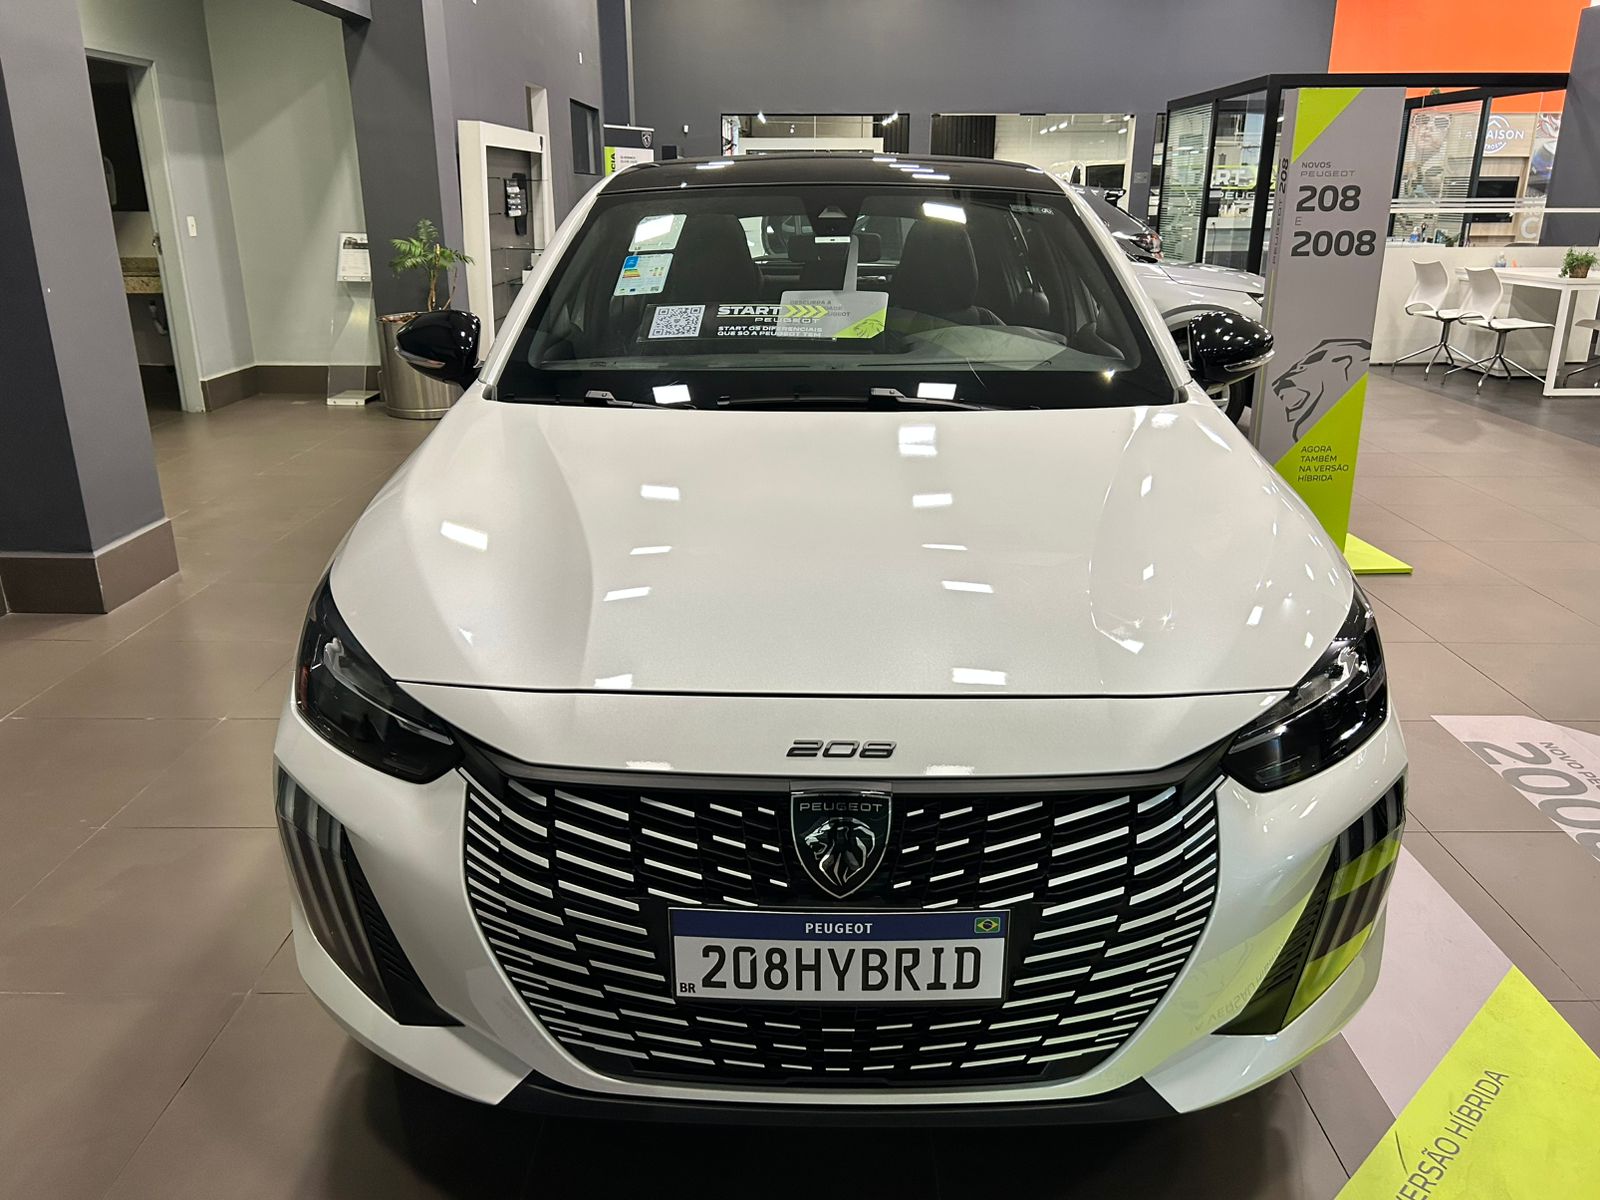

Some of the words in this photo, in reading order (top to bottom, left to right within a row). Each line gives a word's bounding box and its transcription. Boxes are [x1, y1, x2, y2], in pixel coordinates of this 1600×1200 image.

[1484, 130, 1524, 140] AISON
[1301, 161, 1331, 169] NOVOS
[1279, 158, 1289, 194] 208
[1300, 170, 1356, 178] PEUGEOT
[1296, 184, 1361, 212] 208
[1295, 216, 1302, 226] E
[1290, 230, 1376, 257] 2008
[717, 306, 782, 315] START
[1301, 455, 1337, 463] TAMBÉM
[1298, 465, 1312, 473] NA
[1313, 464, 1349, 472] VERSÃO
[1297, 474, 1333, 482] HÍBRIDA
[786, 740, 897, 758] 208
[1540, 741, 1585, 769] NOVO
[800, 801, 883, 813] PEUGEOT
[805, 922, 873, 935] PEUGEOT
[701, 944, 982, 992] 208HYBRID
[680, 982, 696, 994] BR
[1395, 1136, 1461, 1200] ERSÃO
[1444, 1070, 1510, 1140] HÍBRIDA
